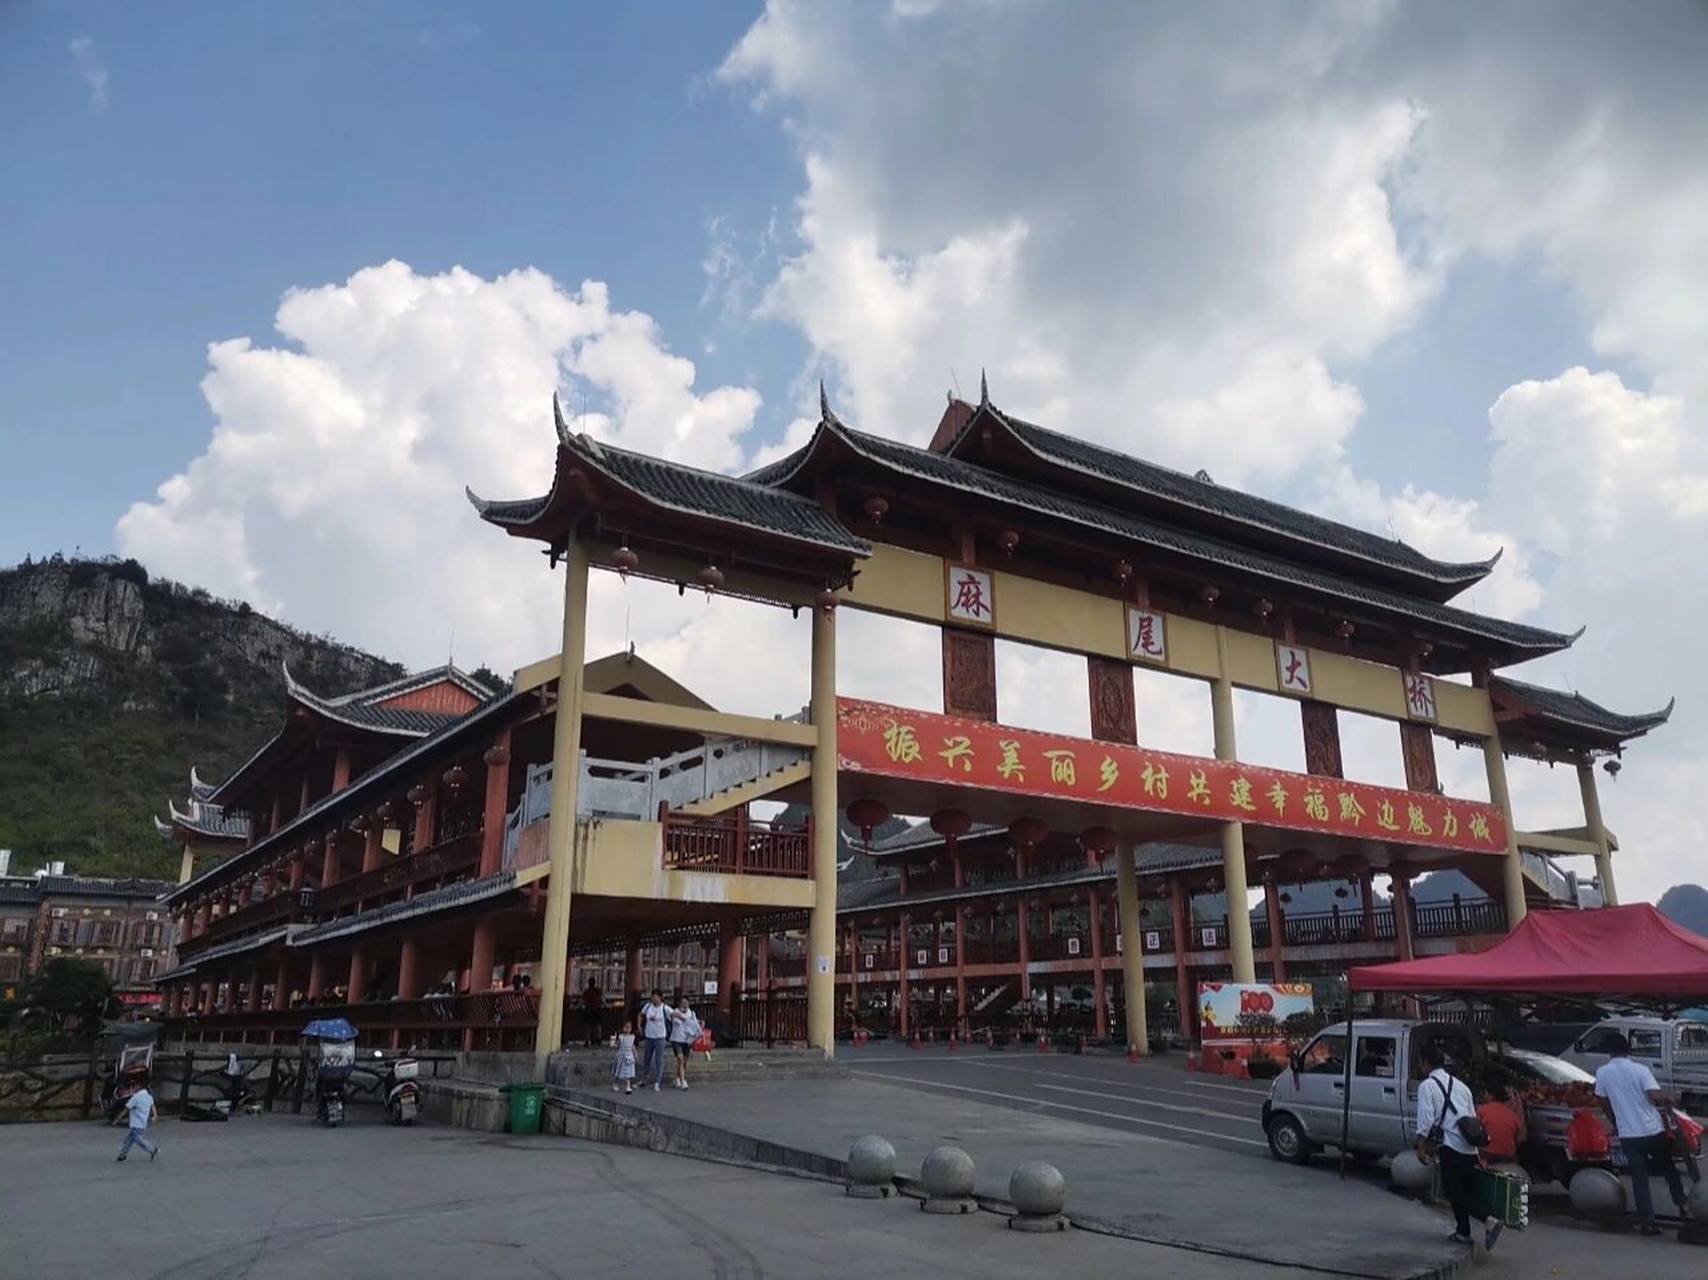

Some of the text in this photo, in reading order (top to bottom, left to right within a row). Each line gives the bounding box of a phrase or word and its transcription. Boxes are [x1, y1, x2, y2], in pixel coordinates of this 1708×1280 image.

[952, 573, 1432, 716] 麻尾大桥
[1240, 990, 1274, 1012] 100
